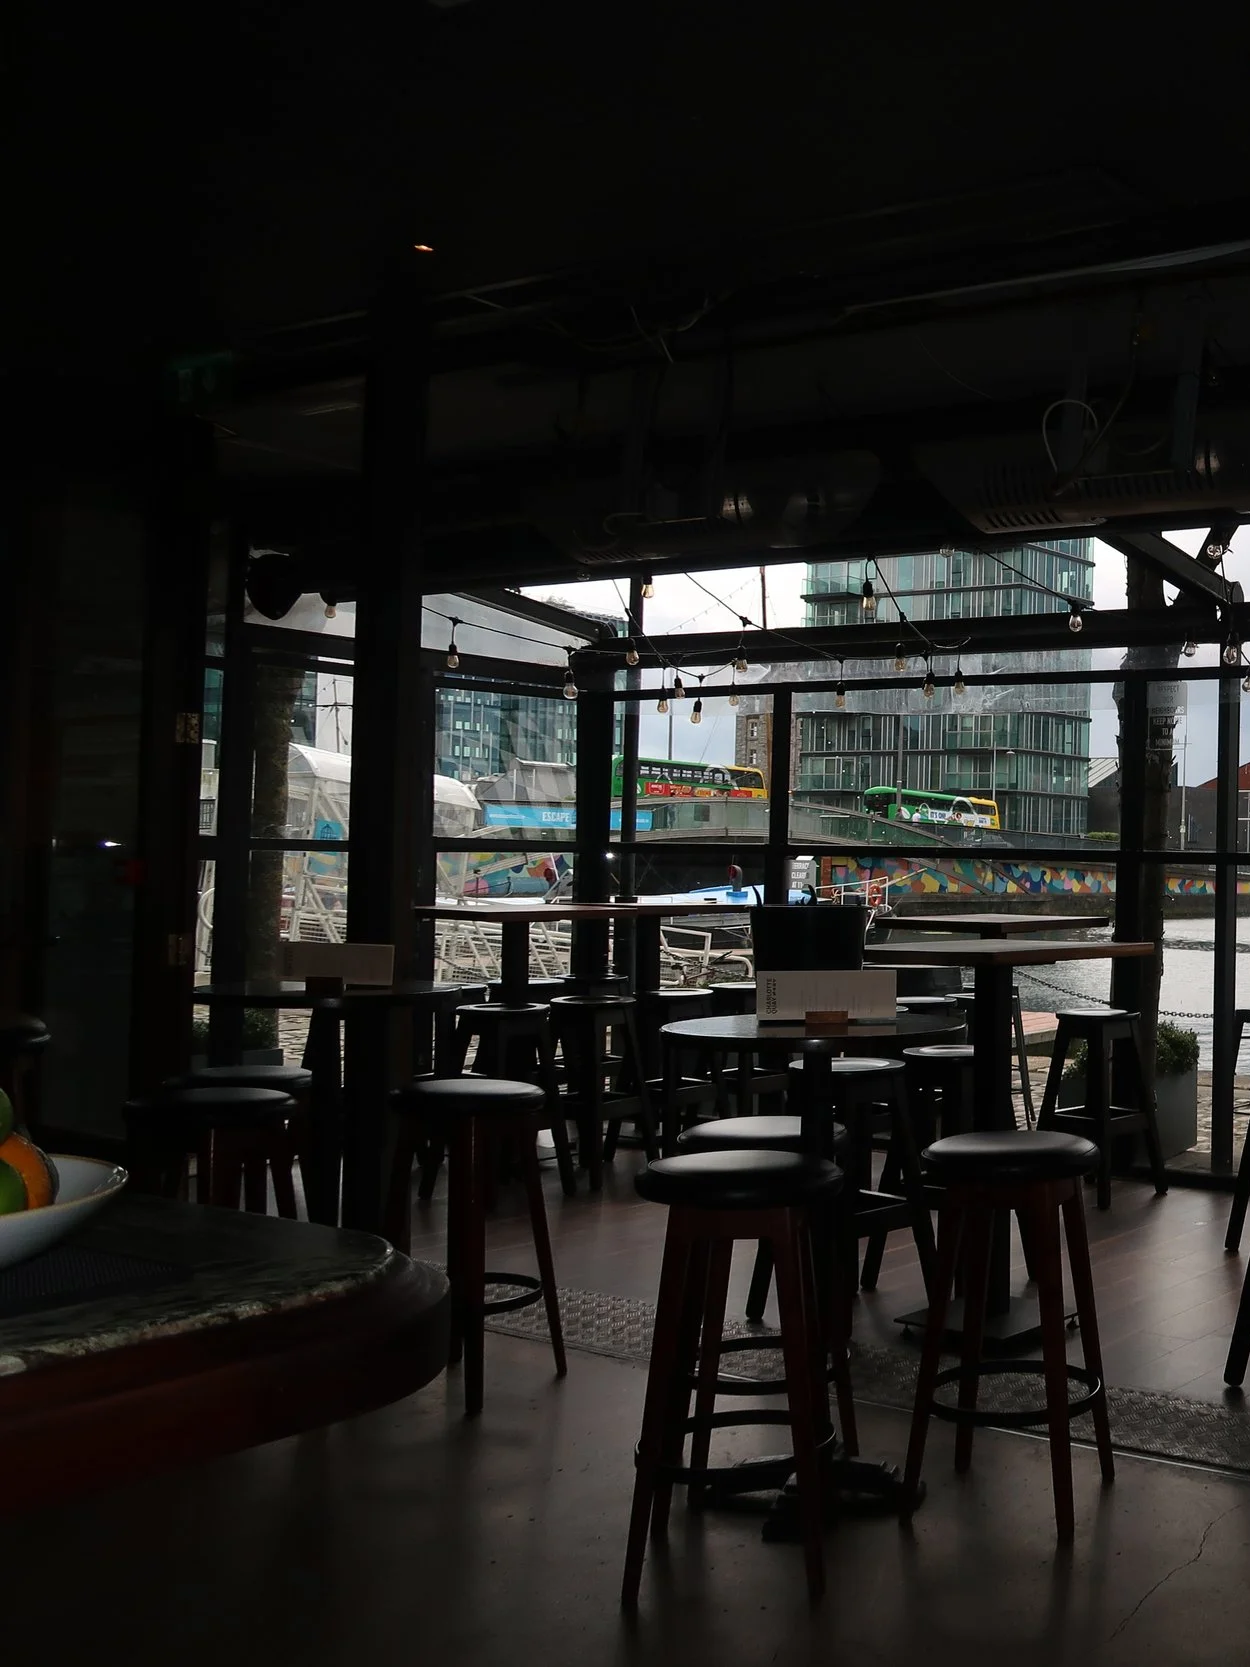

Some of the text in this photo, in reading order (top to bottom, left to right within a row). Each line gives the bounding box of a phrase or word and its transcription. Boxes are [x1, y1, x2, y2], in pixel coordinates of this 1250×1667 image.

[1153, 717, 1166, 725] KEEP
[1162, 728, 1169, 736] TO
[543, 812, 570, 822] ESCAPE
